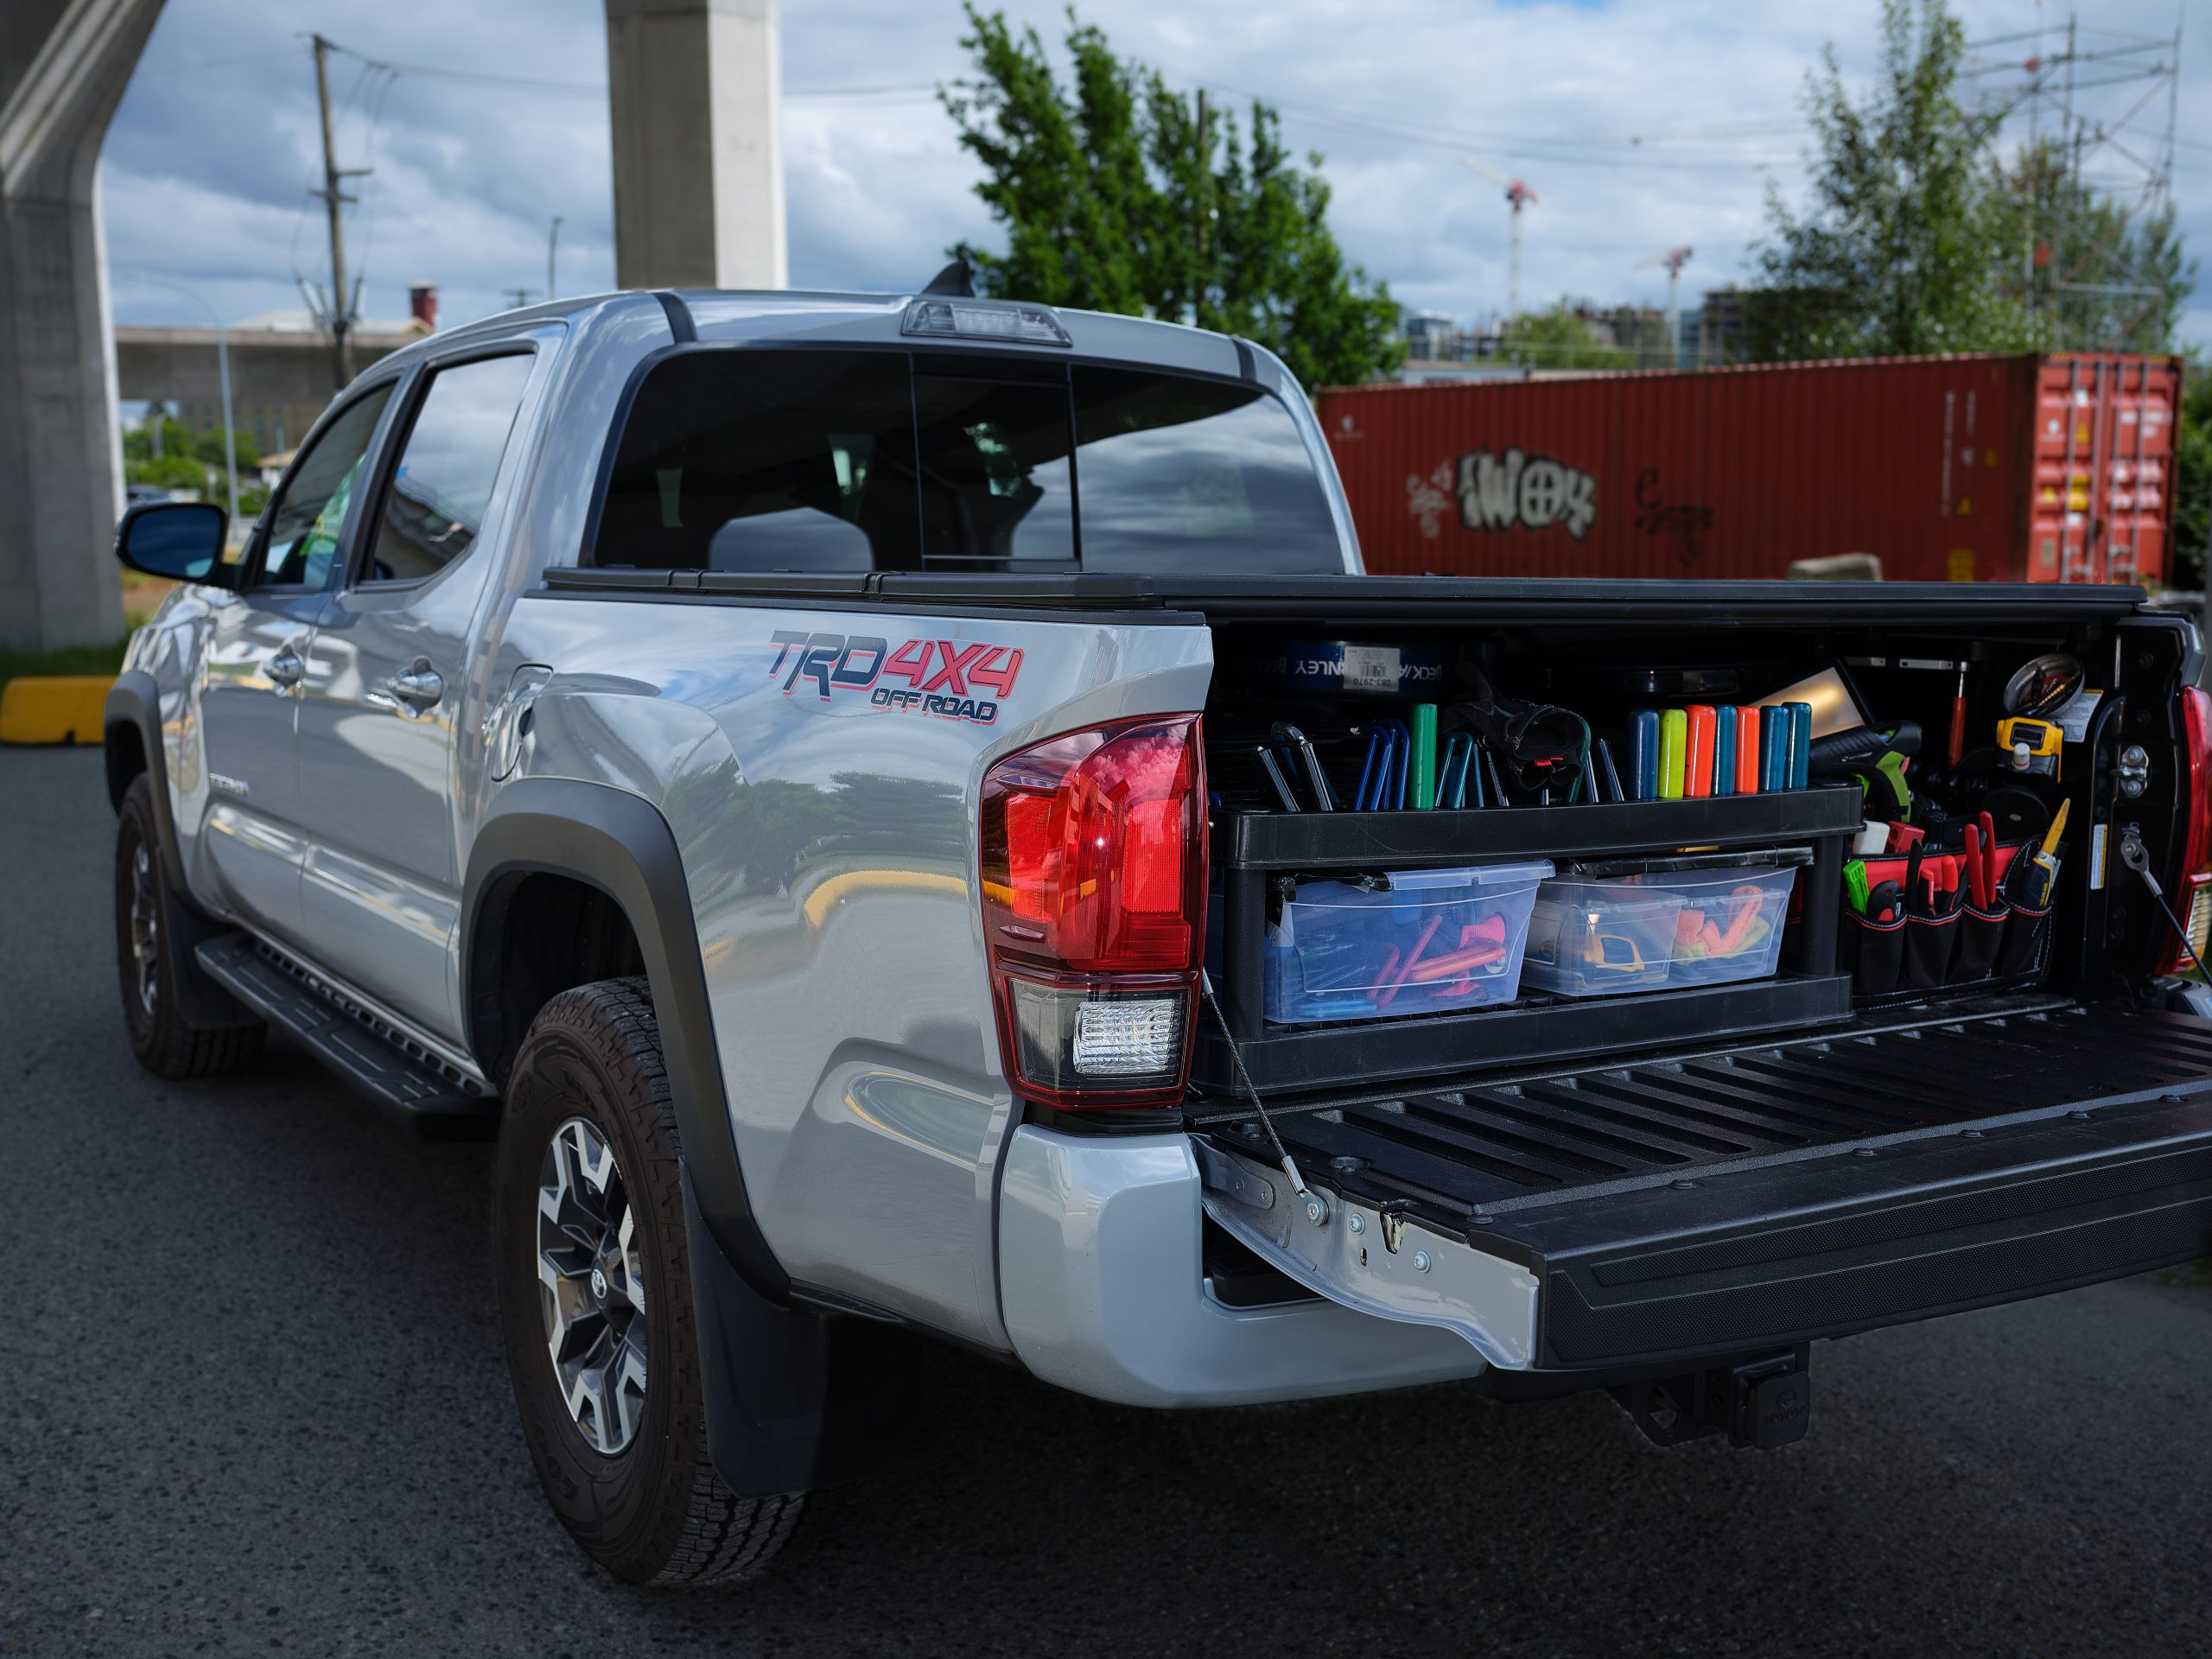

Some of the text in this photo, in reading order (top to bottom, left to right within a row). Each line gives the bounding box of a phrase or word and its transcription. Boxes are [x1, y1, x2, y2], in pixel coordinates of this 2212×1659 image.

[769, 630, 1026, 702] TRD 4X4
[870, 687, 1000, 727] OFF ROAD
